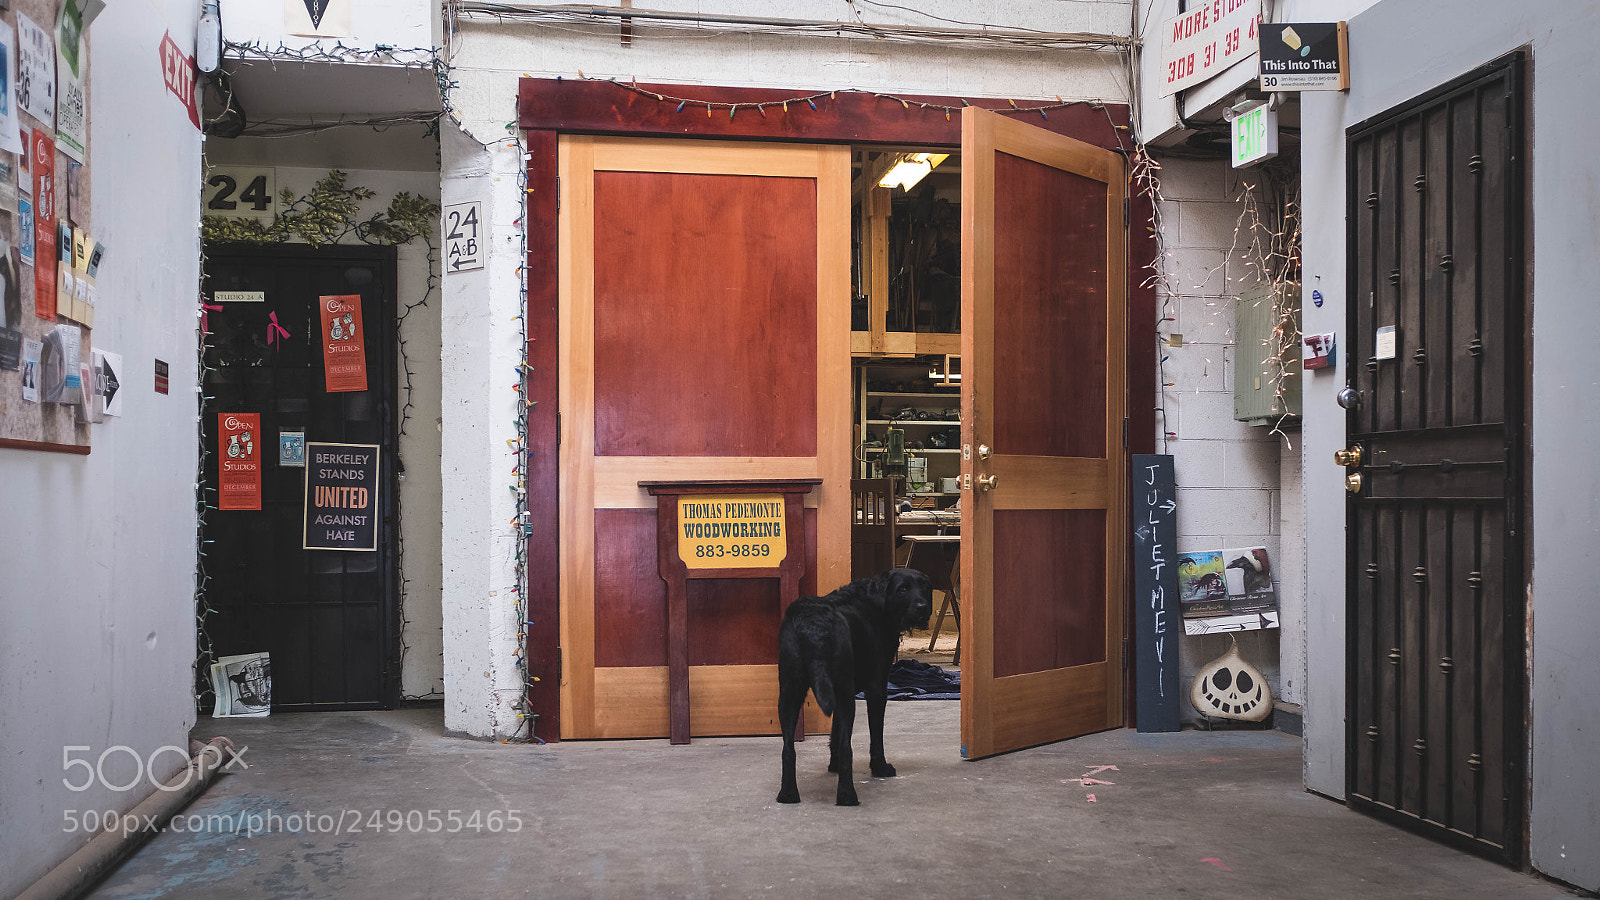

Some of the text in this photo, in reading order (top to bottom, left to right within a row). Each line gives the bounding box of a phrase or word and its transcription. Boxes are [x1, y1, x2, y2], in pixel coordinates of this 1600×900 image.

[1174, 6, 1210, 43] MORE
[1167, 53, 1195, 83] 30B
[1203, 41, 1217, 68] 31
[1225, 27, 1240, 56] 39
[165, 39, 193, 107] EXIT
[1262, 59, 1337, 71] This Into That
[1264, 77, 1278, 87] 30
[1237, 109, 1262, 161] EXIT
[208, 174, 272, 211] 24
[447, 205, 479, 240] 24
[223, 460, 258, 472] STUDIOS
[315, 453, 370, 465] BERKELEY
[319, 468, 365, 481] STANDS
[314, 485, 368, 509] UNITED
[682, 502, 782, 519] THOMAS PEDEMONTE
[314, 514, 368, 526] AGAINST
[683, 521, 781, 539] WOODWORKING
[695, 543, 770, 558] 883-9859
